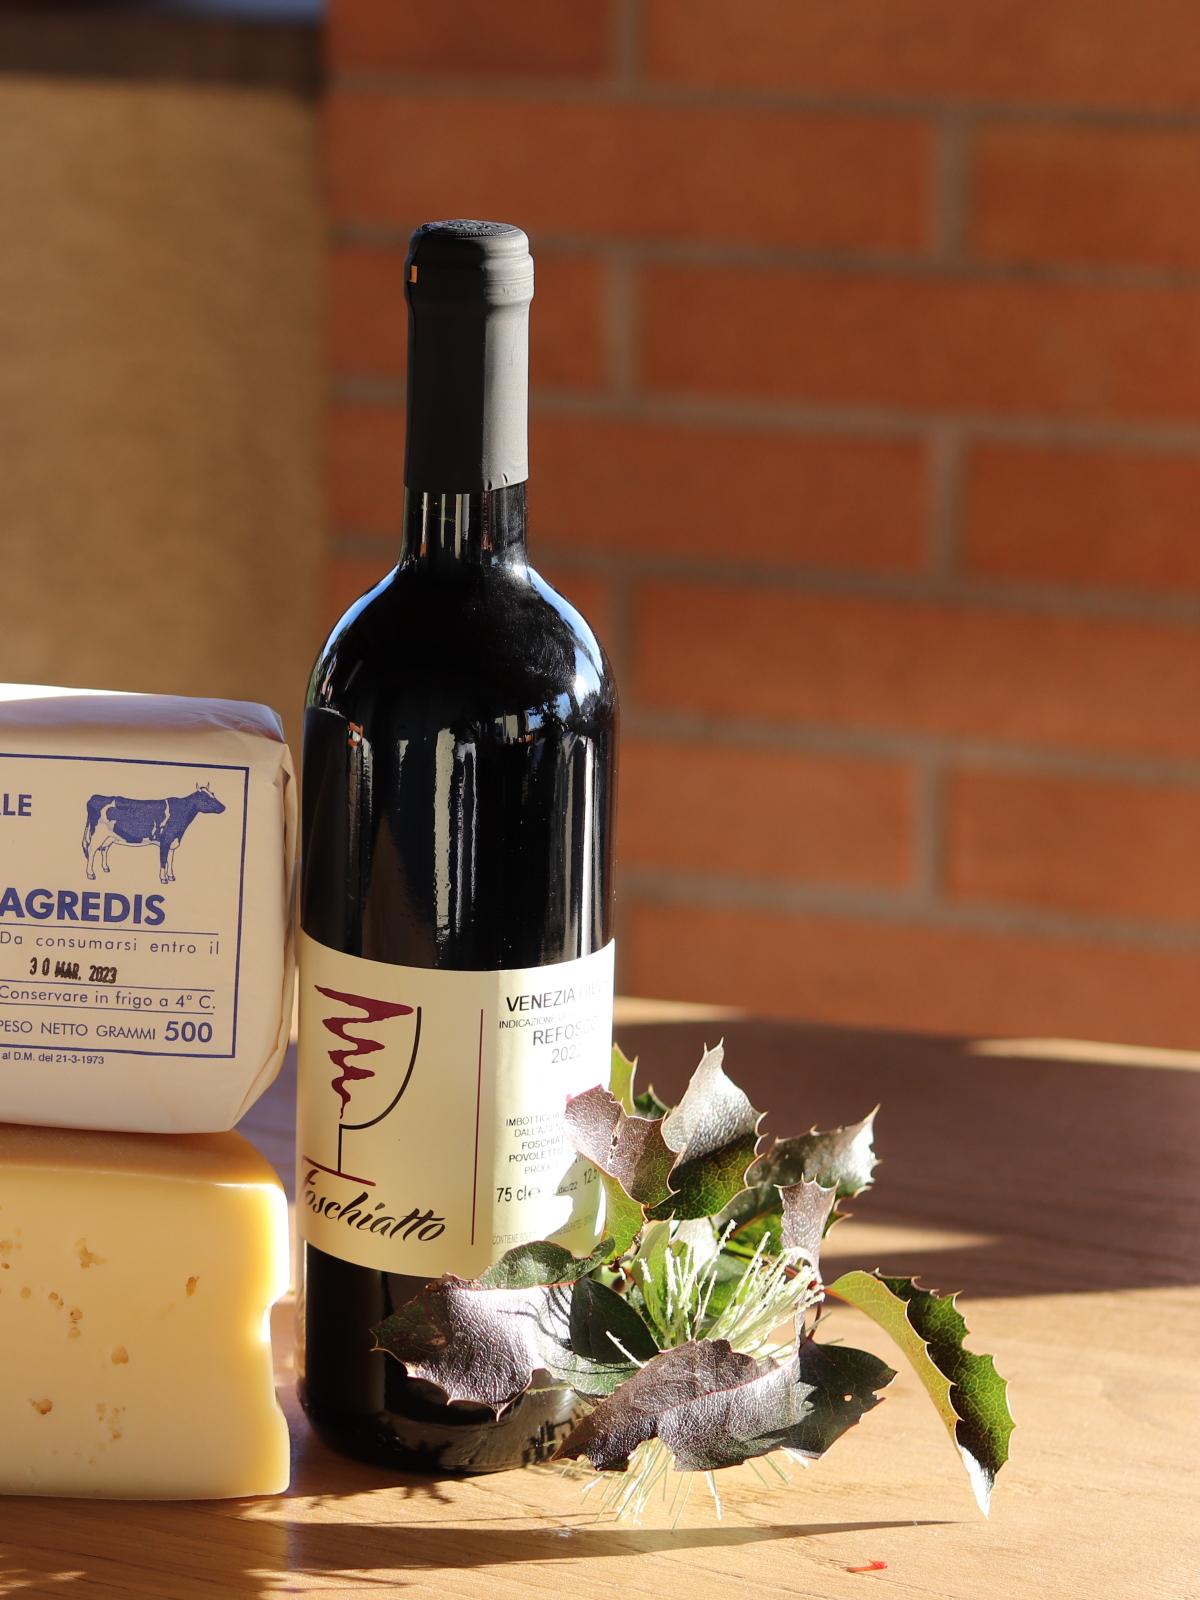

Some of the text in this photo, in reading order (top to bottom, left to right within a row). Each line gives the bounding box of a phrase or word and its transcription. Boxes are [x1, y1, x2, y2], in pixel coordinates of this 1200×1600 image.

[0, 931, 23, 945] Da
[35, 935, 137, 952] consumarsi
[149, 940, 197, 955] entro
[209, 941, 220, 956] il
[88, 965, 118, 984] 2023
[95, 990, 109, 1004] in
[115, 991, 152, 1012] frigo
[159, 998, 168, 1008] a
[506, 988, 576, 1012] VENEZIA
[40, 1022, 88, 1037] NETTO
[95, 1025, 156, 1041] GRAMMI
[164, 1020, 213, 1043] 500
[532, 1020, 590, 1046] REFOS
[2, 1051, 12, 1060] al
[13, 1051, 35, 1062] D.M.
[38, 1052, 54, 1063] del
[55, 1053, 105, 1065] 21-3-1973
[551, 1044, 580, 1064] 202
[496, 1187, 512, 1203] 75
[516, 1185, 527, 1201] cl
